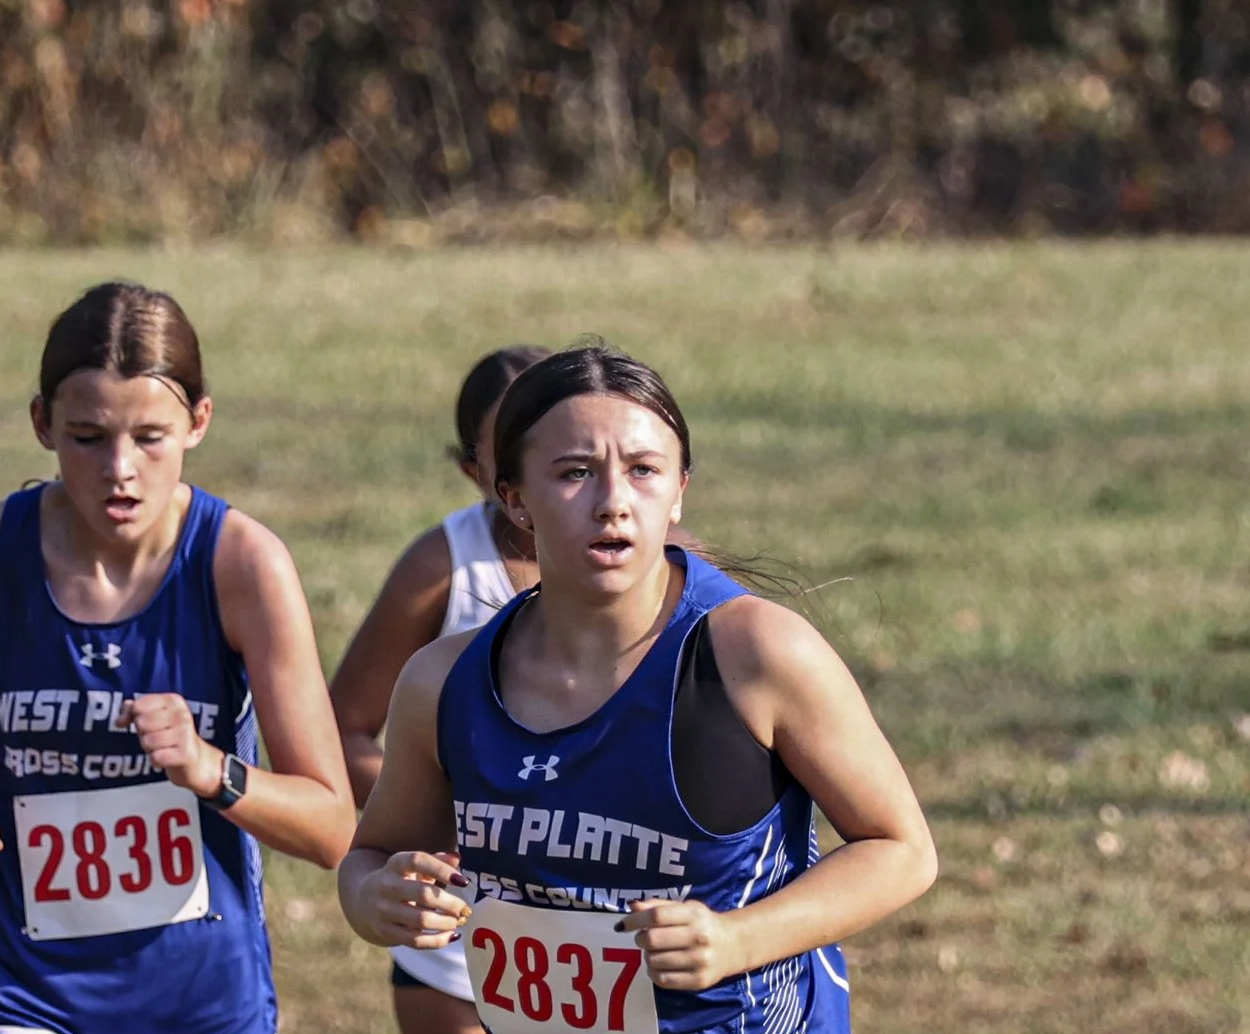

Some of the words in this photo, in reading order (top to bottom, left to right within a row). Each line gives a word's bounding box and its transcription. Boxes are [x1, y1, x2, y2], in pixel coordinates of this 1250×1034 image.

[83, 690, 219, 740] PLE
[28, 808, 194, 903] 2836
[453, 800, 514, 852] EST
[517, 807, 689, 877] PLATTE
[471, 926, 642, 1032] 2837
